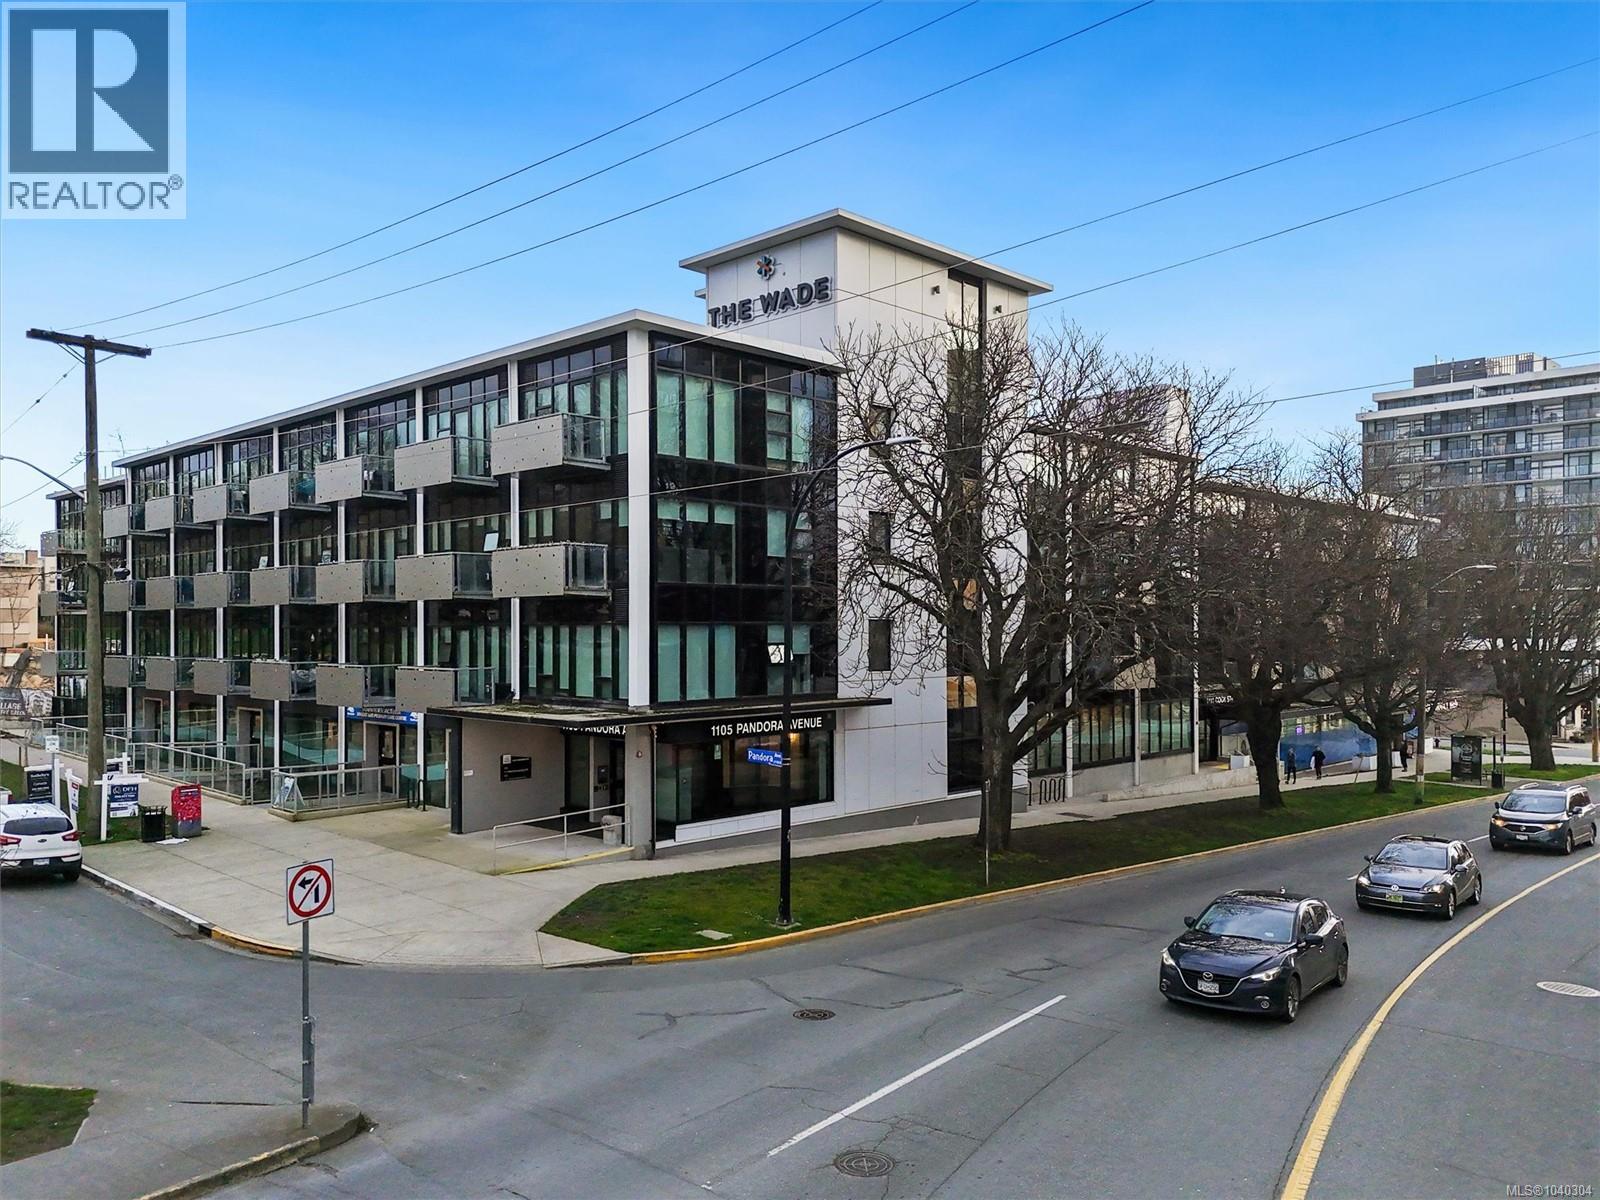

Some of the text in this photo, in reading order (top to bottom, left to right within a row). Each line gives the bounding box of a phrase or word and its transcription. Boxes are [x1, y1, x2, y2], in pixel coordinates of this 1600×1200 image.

[708, 276, 831, 328] THE WADE
[711, 716, 823, 737] 1105 PANDORA VENUE
[748, 750, 774, 763] Pandora
